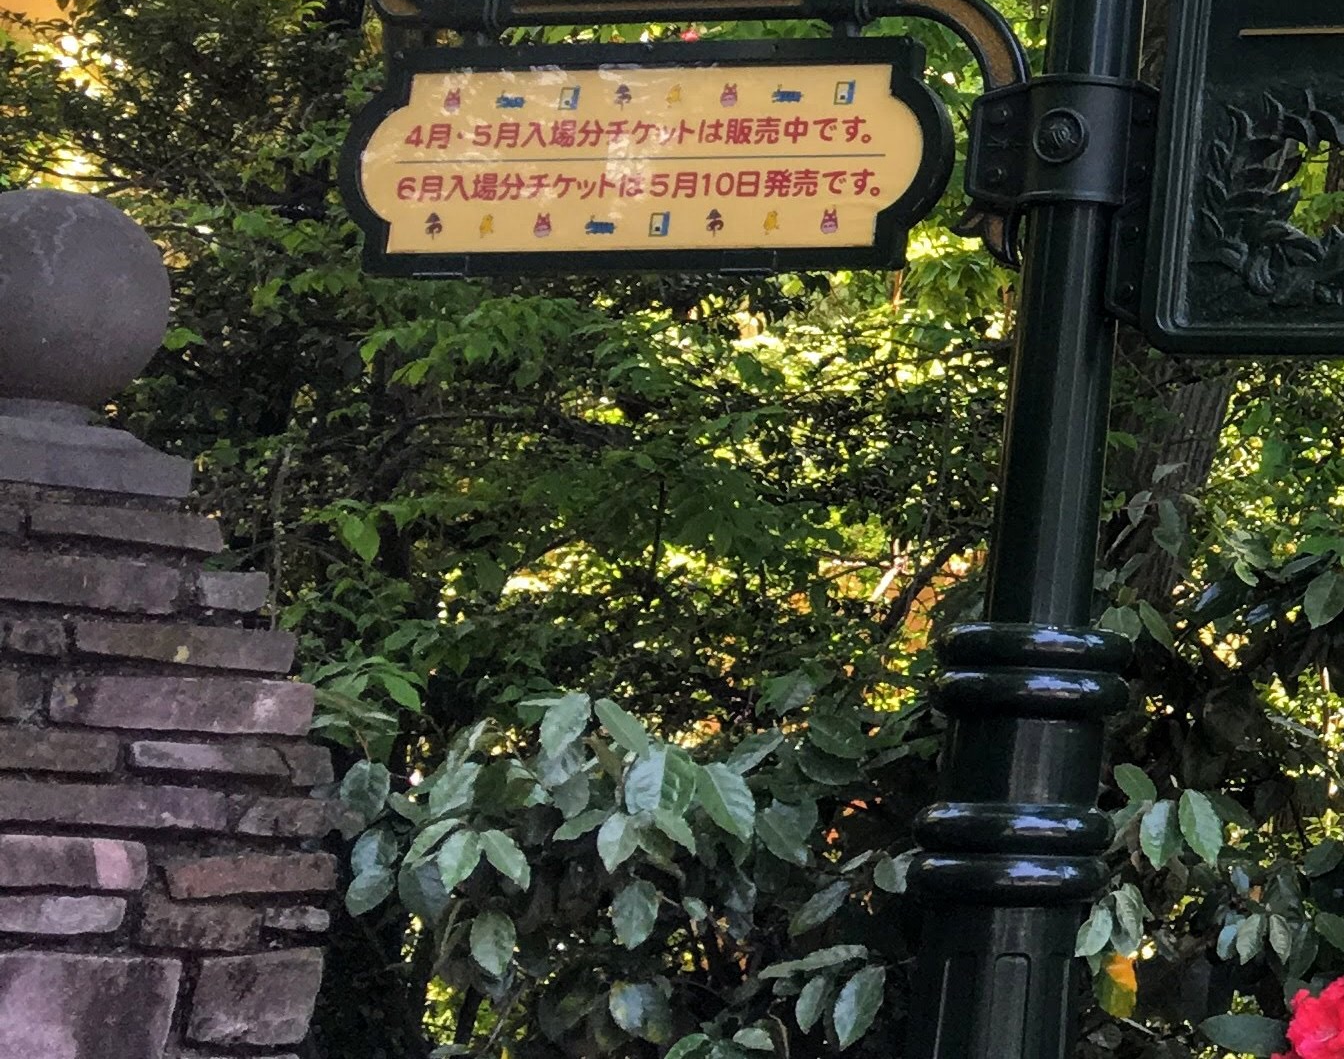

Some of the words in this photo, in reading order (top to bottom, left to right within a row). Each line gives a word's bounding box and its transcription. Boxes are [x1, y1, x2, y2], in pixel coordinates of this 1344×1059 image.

[396, 169, 884, 202] 6月入場分チケットは5月10日発売です。
